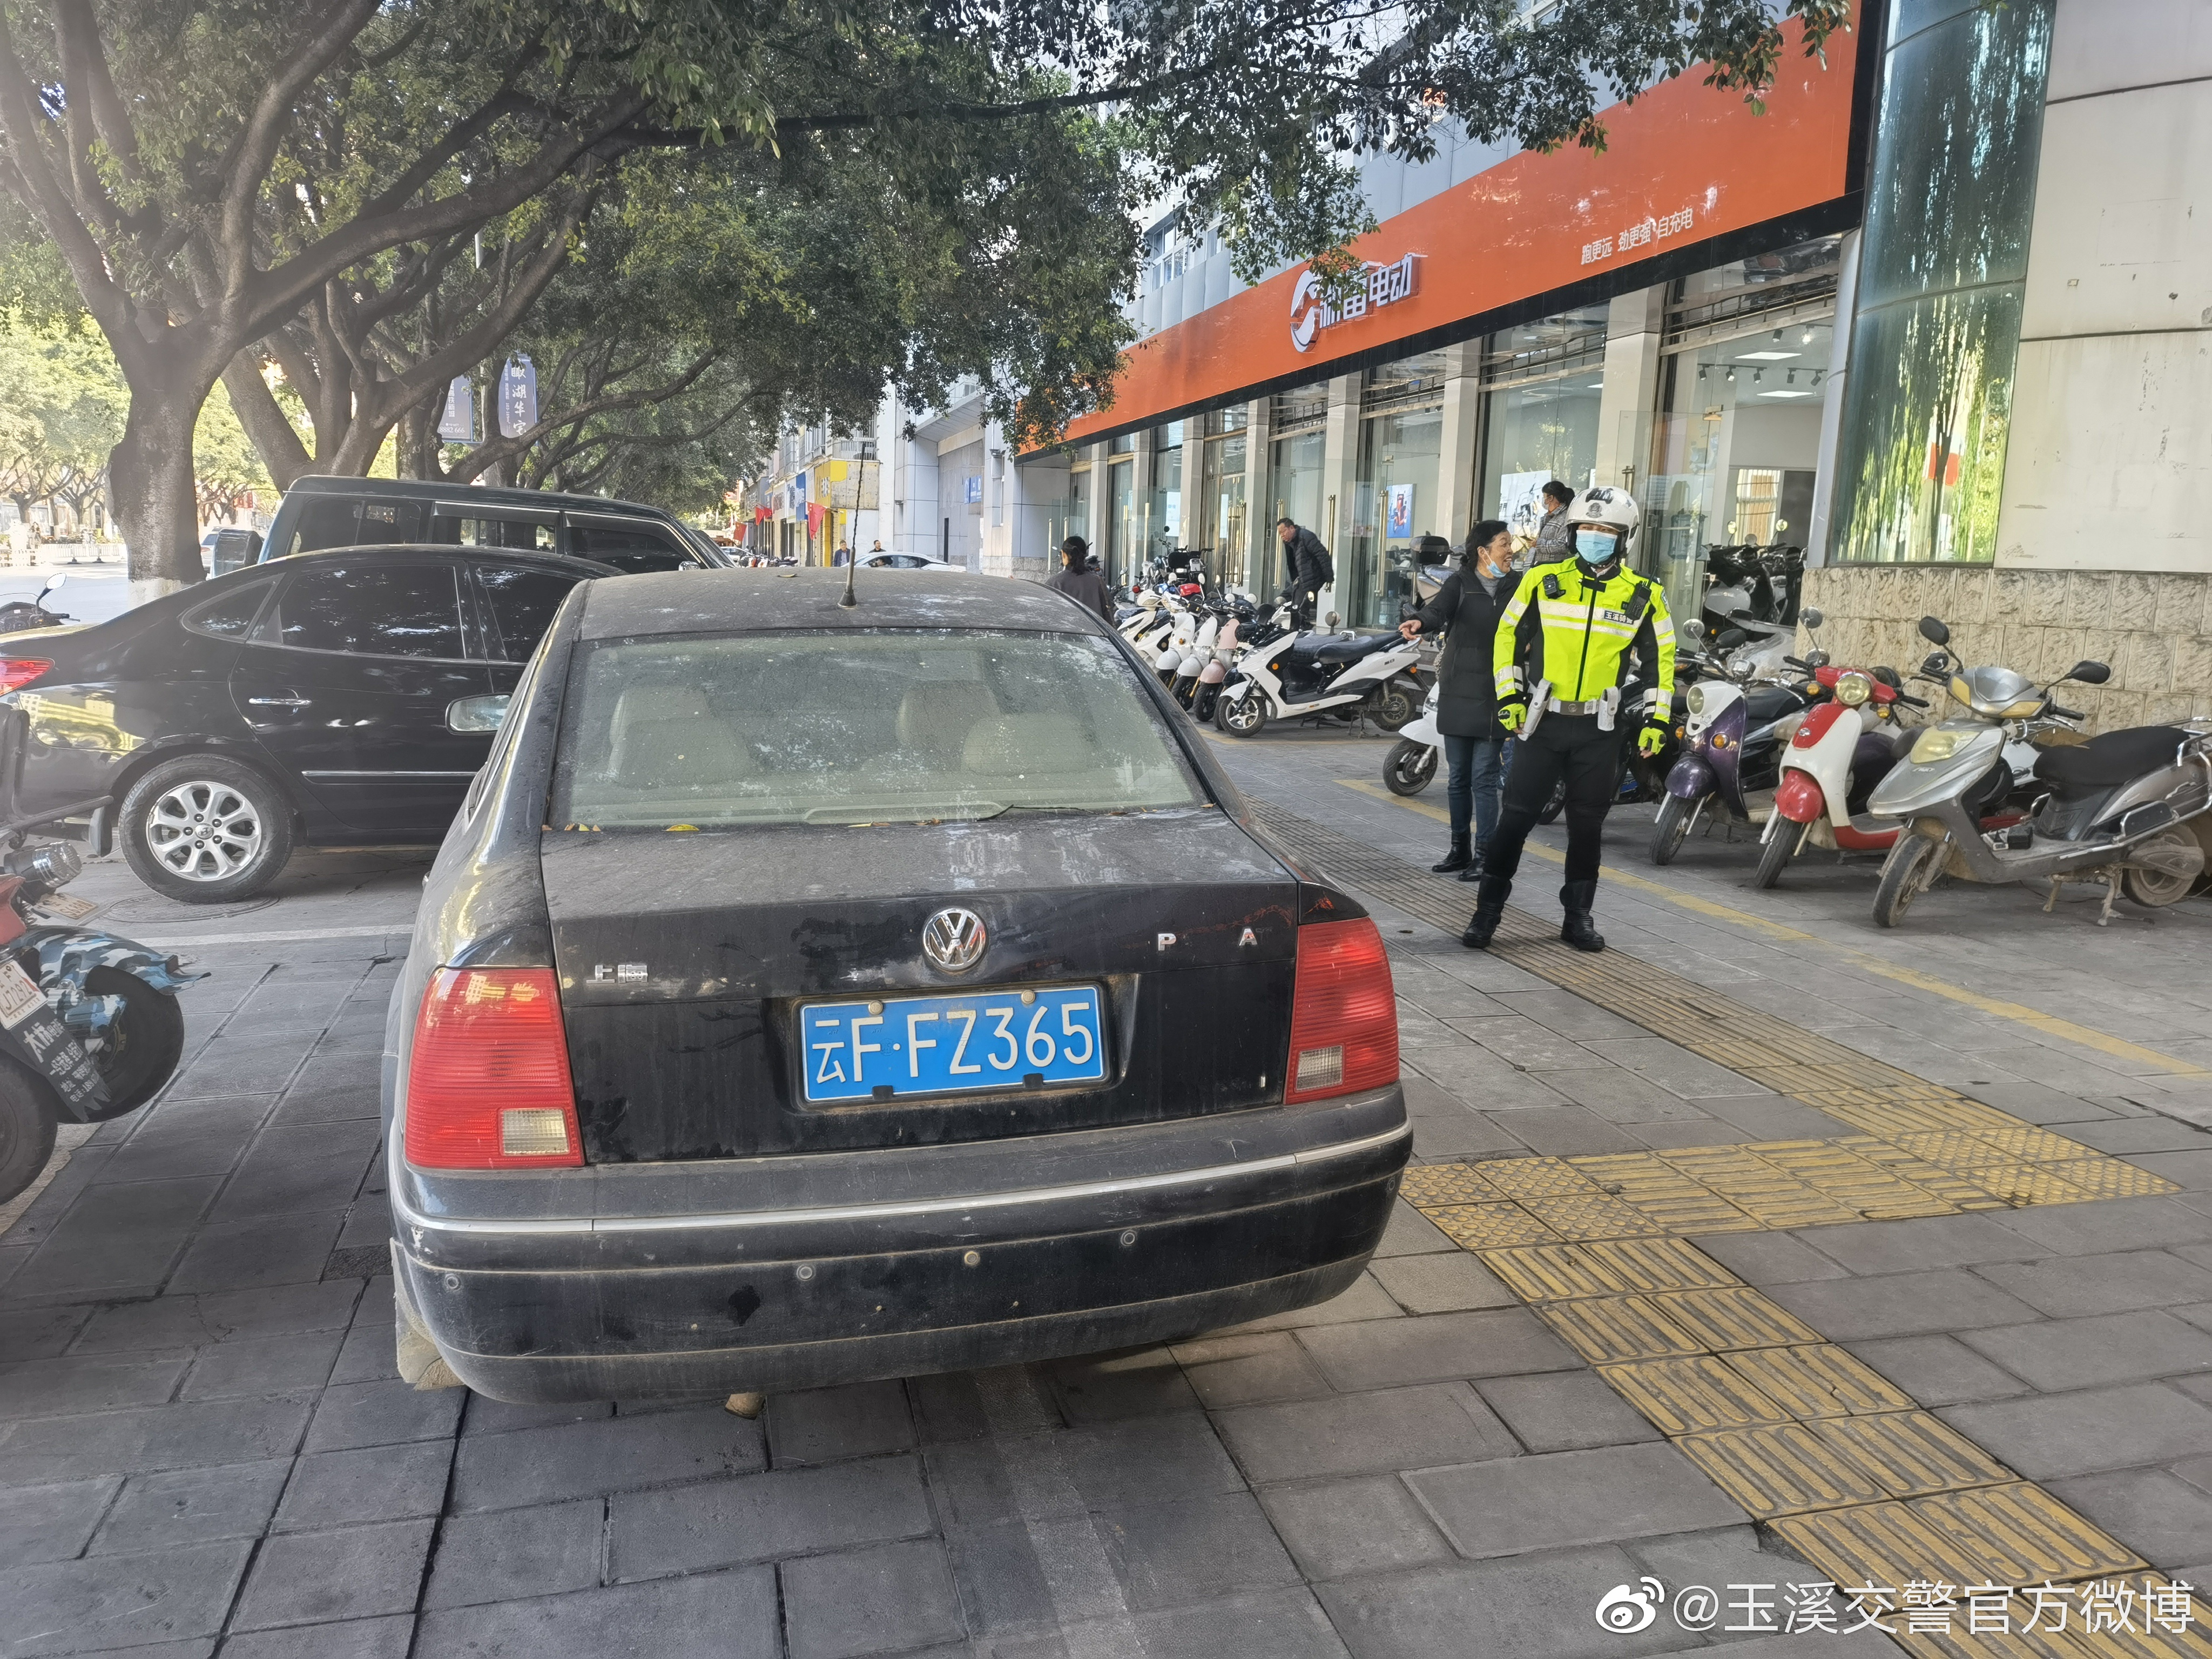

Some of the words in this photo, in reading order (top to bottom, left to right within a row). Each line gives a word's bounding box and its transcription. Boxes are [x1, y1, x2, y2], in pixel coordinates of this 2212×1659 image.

[1581, 236, 1613, 265] 跑更远
[1617, 221, 1651, 252] 劲更强
[1658, 207, 1693, 239] 自充电
